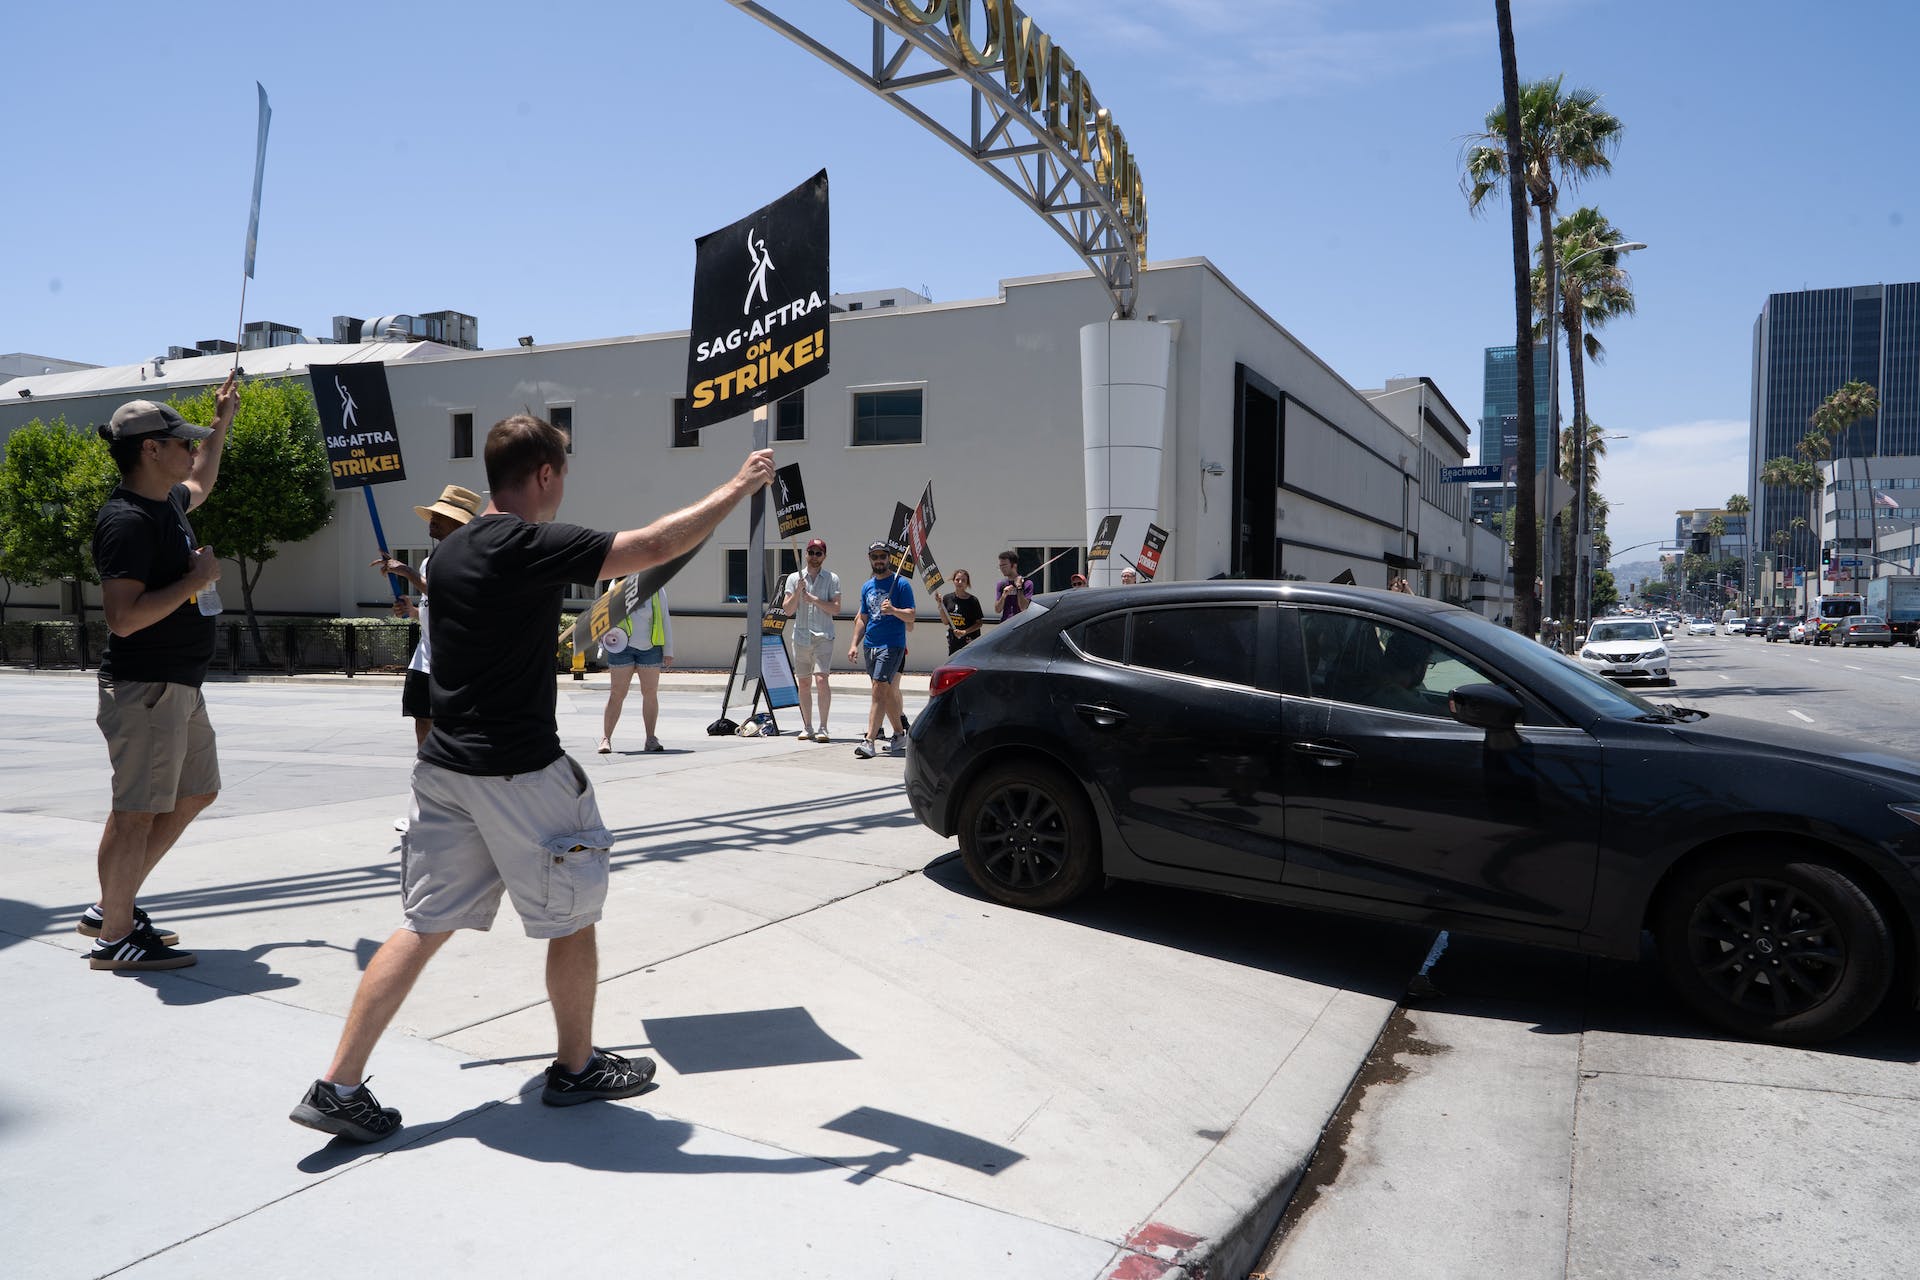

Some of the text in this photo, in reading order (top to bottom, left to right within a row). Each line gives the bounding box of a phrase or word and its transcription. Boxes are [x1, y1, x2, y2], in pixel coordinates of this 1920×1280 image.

[887, 0, 1095, 162] OWER
[746, 338, 771, 360] ON
[692, 329, 825, 408] STRIKE!
[351, 448, 365, 457] ON
[332, 454, 400, 477] STRIKE!
[1442, 467, 1487, 477] Beachwood
